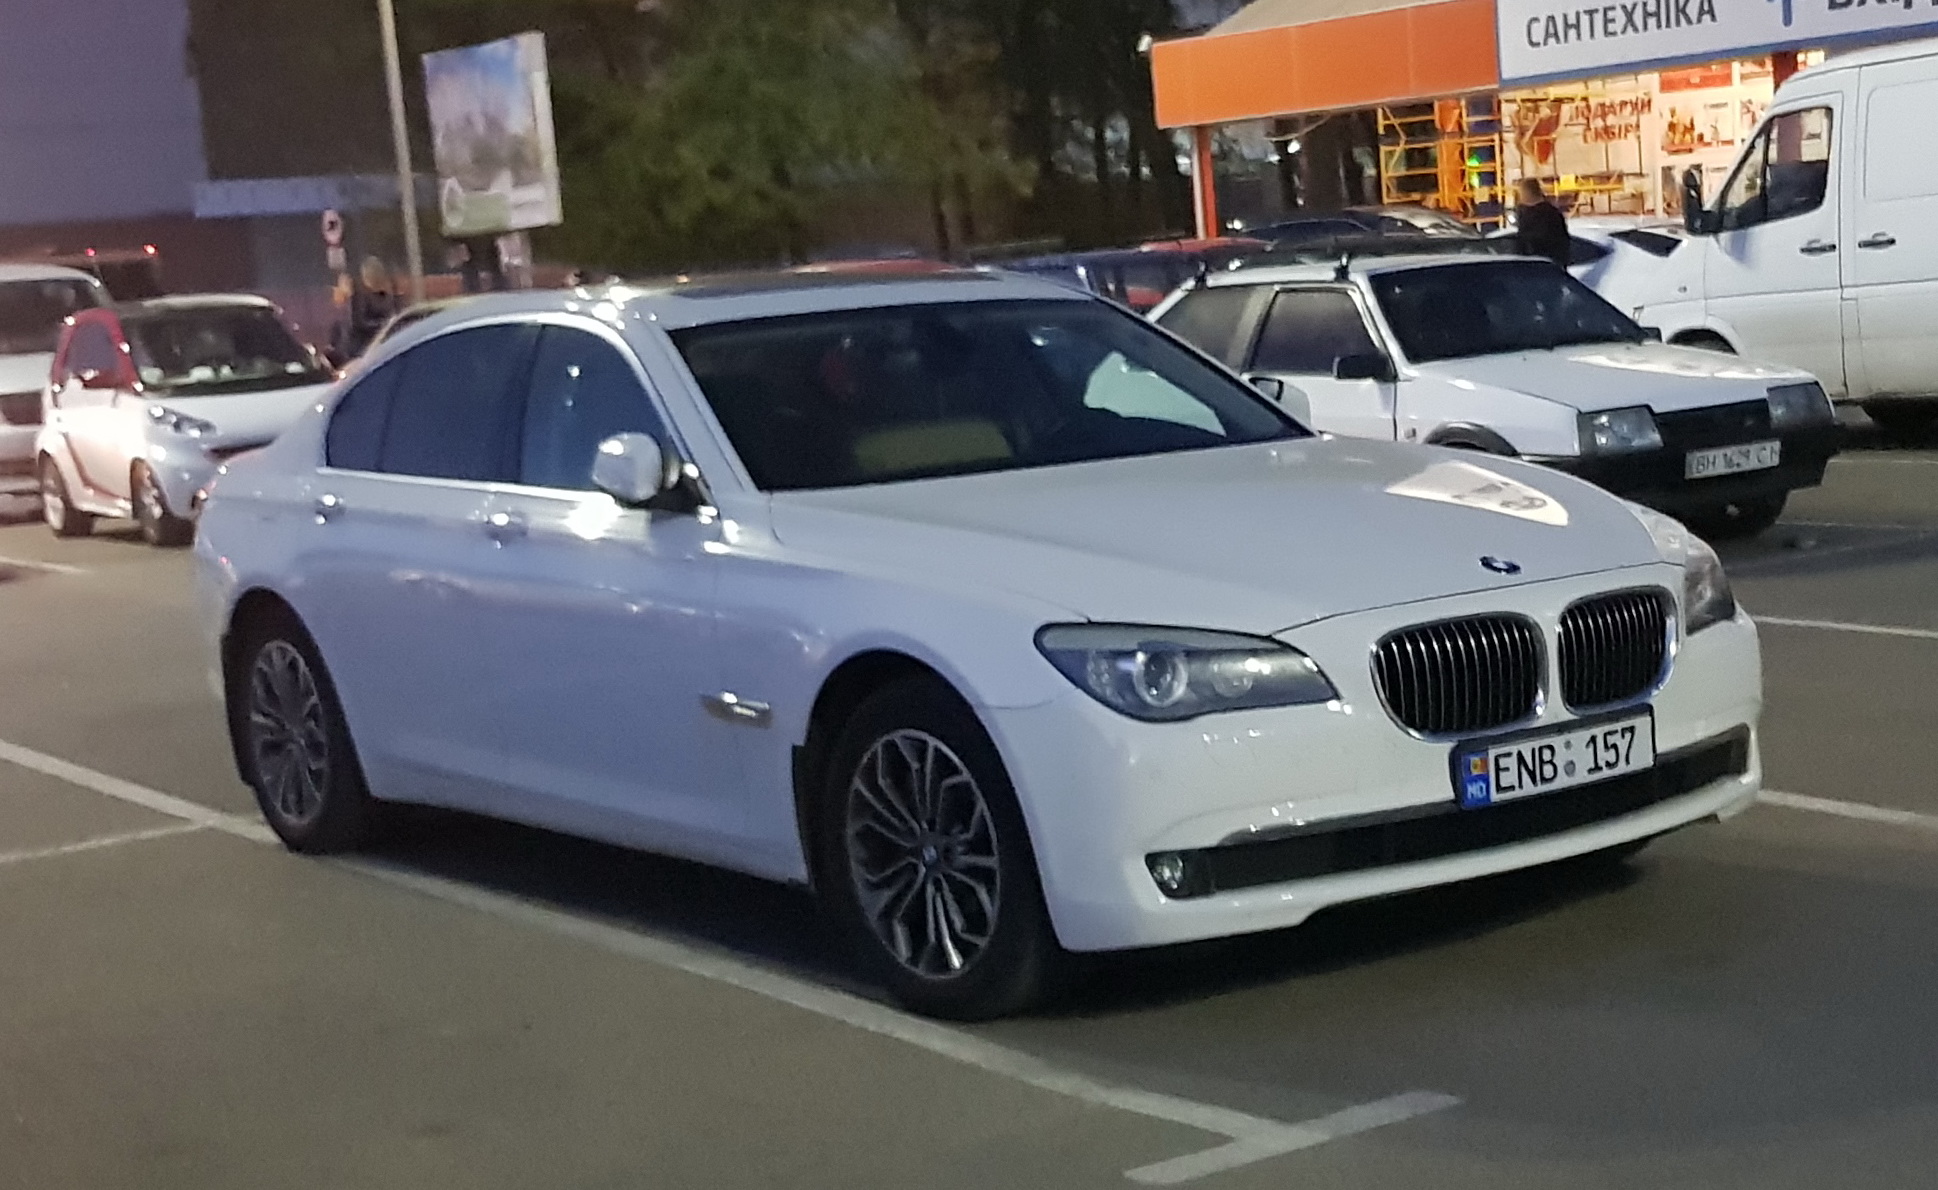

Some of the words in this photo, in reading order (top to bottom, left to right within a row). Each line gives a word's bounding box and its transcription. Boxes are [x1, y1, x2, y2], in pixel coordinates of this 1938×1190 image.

[1526, 0, 1718, 48] САНТЕХНІКА
[1494, 744, 1558, 794] ENB
[1585, 725, 1636, 775] 157
